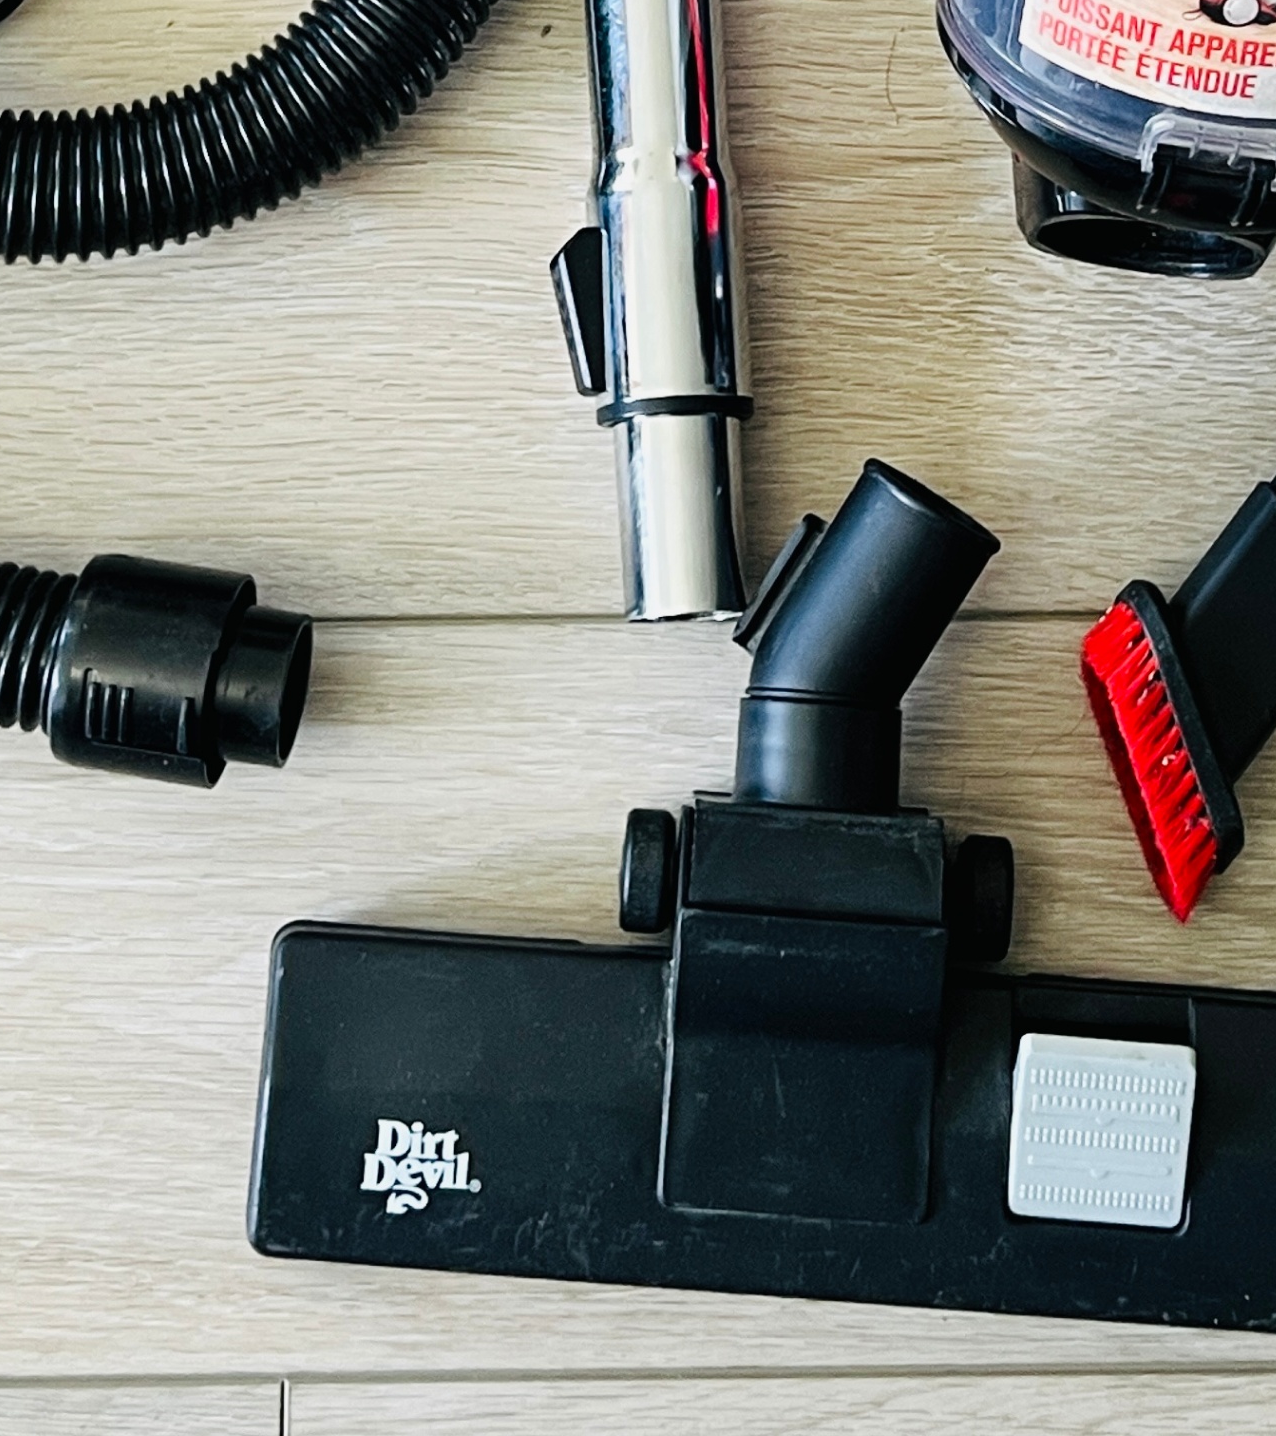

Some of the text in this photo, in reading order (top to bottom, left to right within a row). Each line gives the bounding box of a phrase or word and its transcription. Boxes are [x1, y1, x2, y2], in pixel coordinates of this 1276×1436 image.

[1039, 11, 1258, 99] PORTÉE ÉTENDUE
[375, 1118, 460, 1162] Dirt
